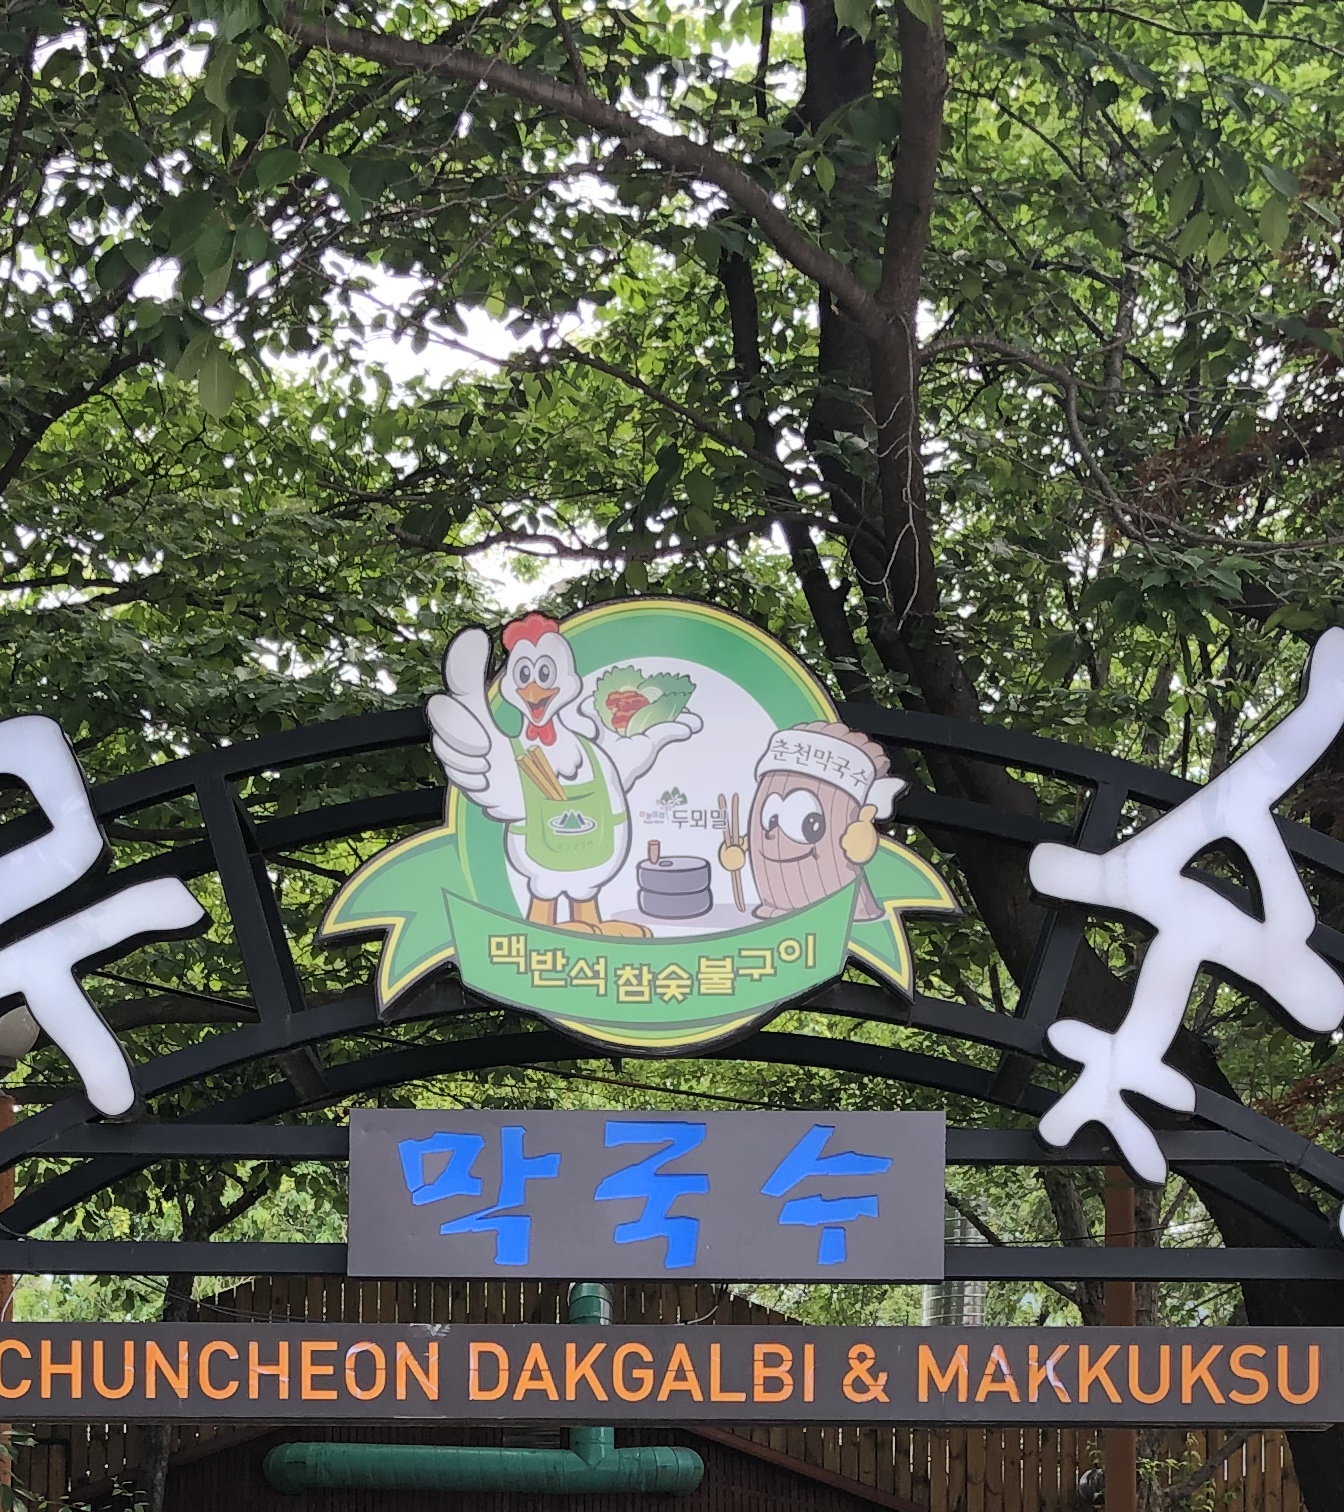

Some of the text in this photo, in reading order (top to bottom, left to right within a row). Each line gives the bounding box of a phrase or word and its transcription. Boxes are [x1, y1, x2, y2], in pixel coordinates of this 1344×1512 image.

[770, 738, 868, 787] 춘천막국수
[398, 1119, 895, 1269] 막국수
[468, 1341, 816, 1402] DAKGALBI
[841, 1343, 891, 1403] &
[917, 1343, 1321, 1404] MAKKUKSU
